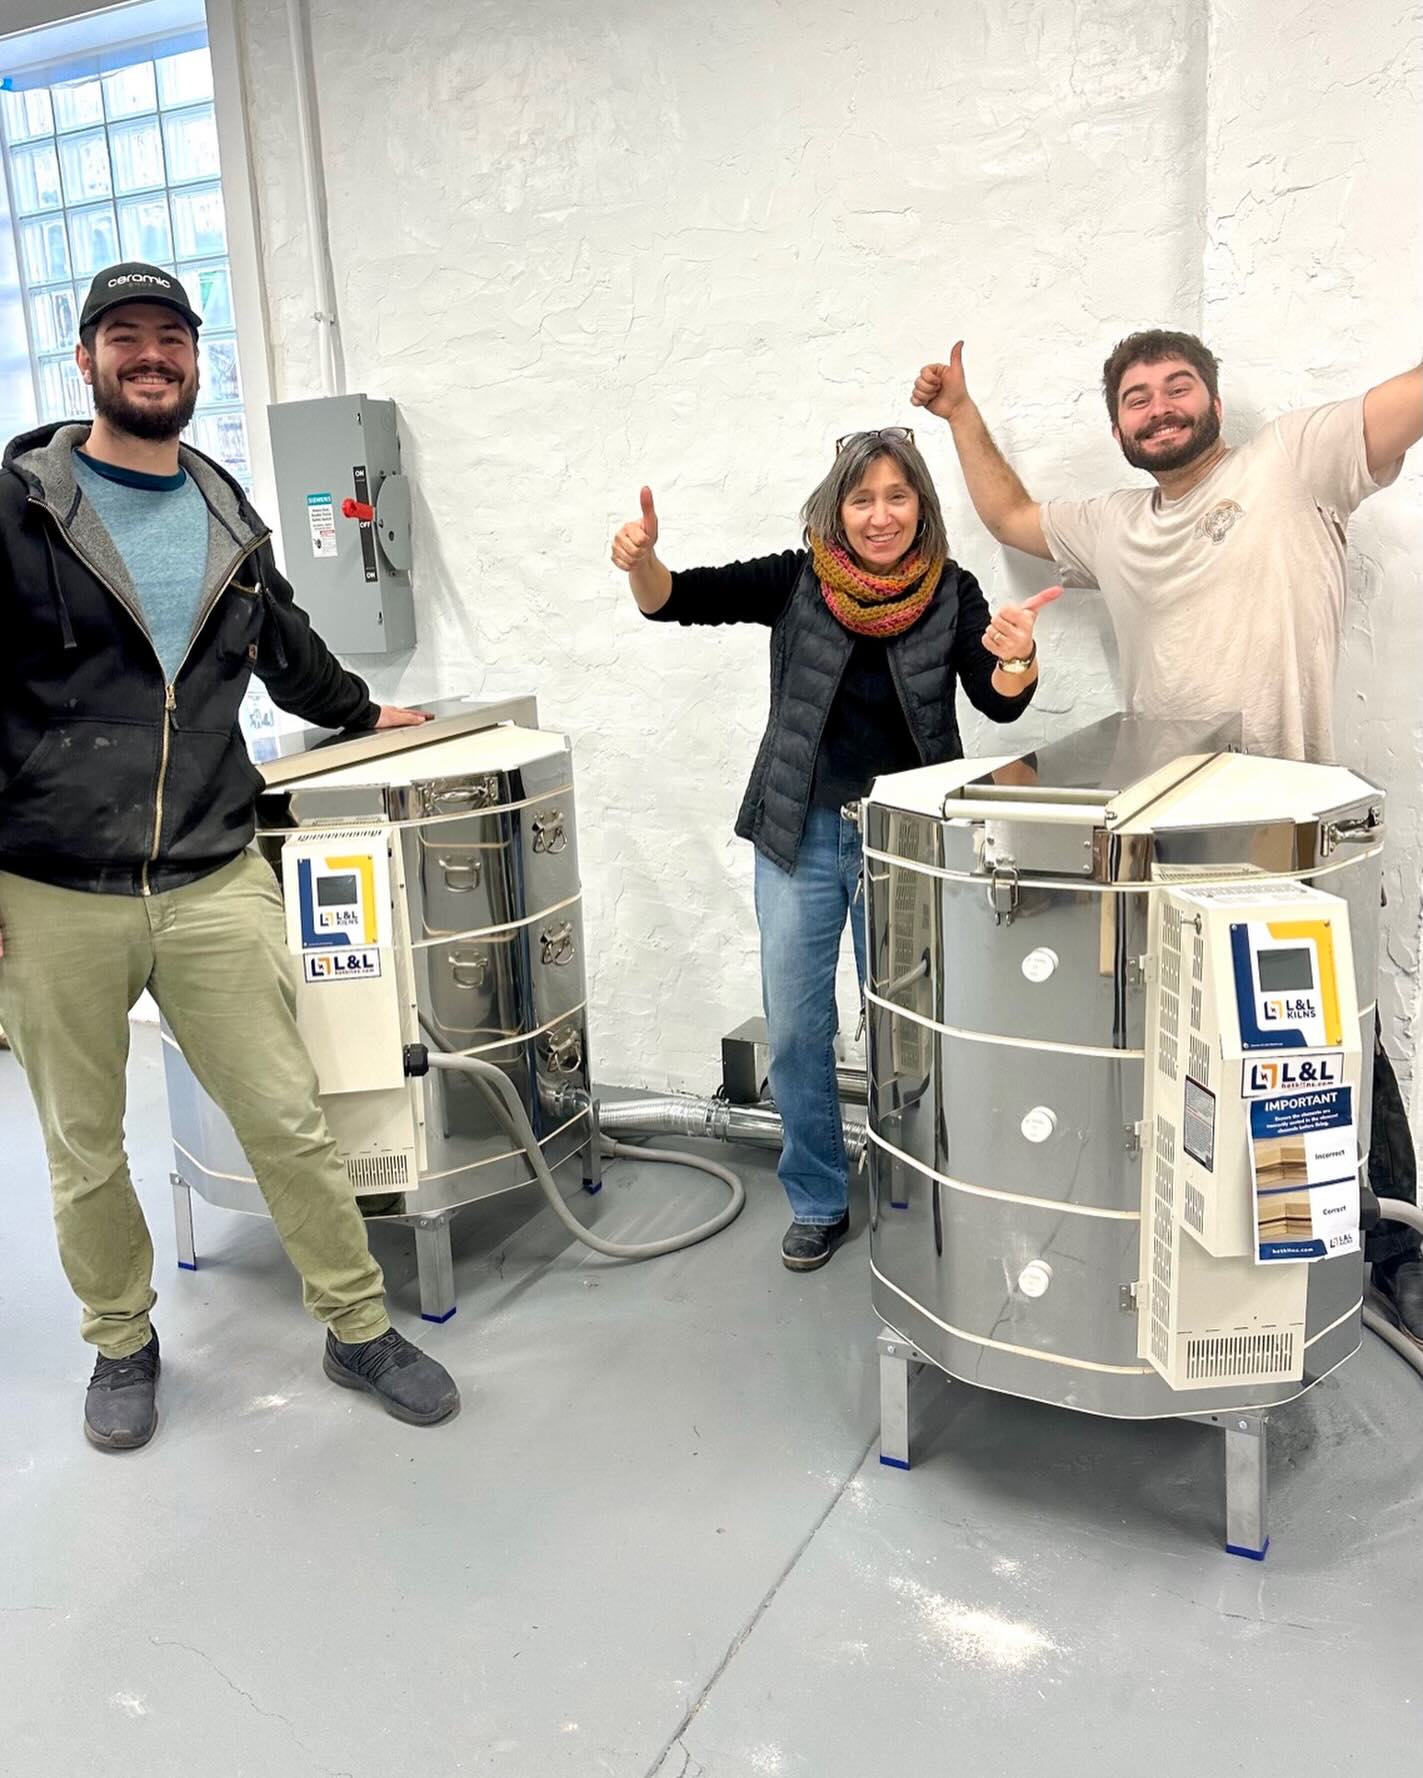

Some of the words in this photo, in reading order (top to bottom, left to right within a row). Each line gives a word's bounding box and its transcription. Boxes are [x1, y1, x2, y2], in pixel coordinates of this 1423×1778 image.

[108, 274, 171, 288] ceramic
[308, 496, 331, 504] SIEMENS
[366, 571, 376, 579] ON
[336, 911, 358, 921] L&L
[333, 954, 374, 971] L&L
[1286, 999, 1315, 1011] L&L
[1287, 1010, 1316, 1019] KILNS
[1282, 1061, 1334, 1083] L&L
[1281, 1081, 1334, 1089] hotkilns.com
[1264, 1091, 1338, 1112] IMPORTANT
[1315, 1149, 1346, 1160] Incorrect
[1322, 1205, 1347, 1216] Correct
